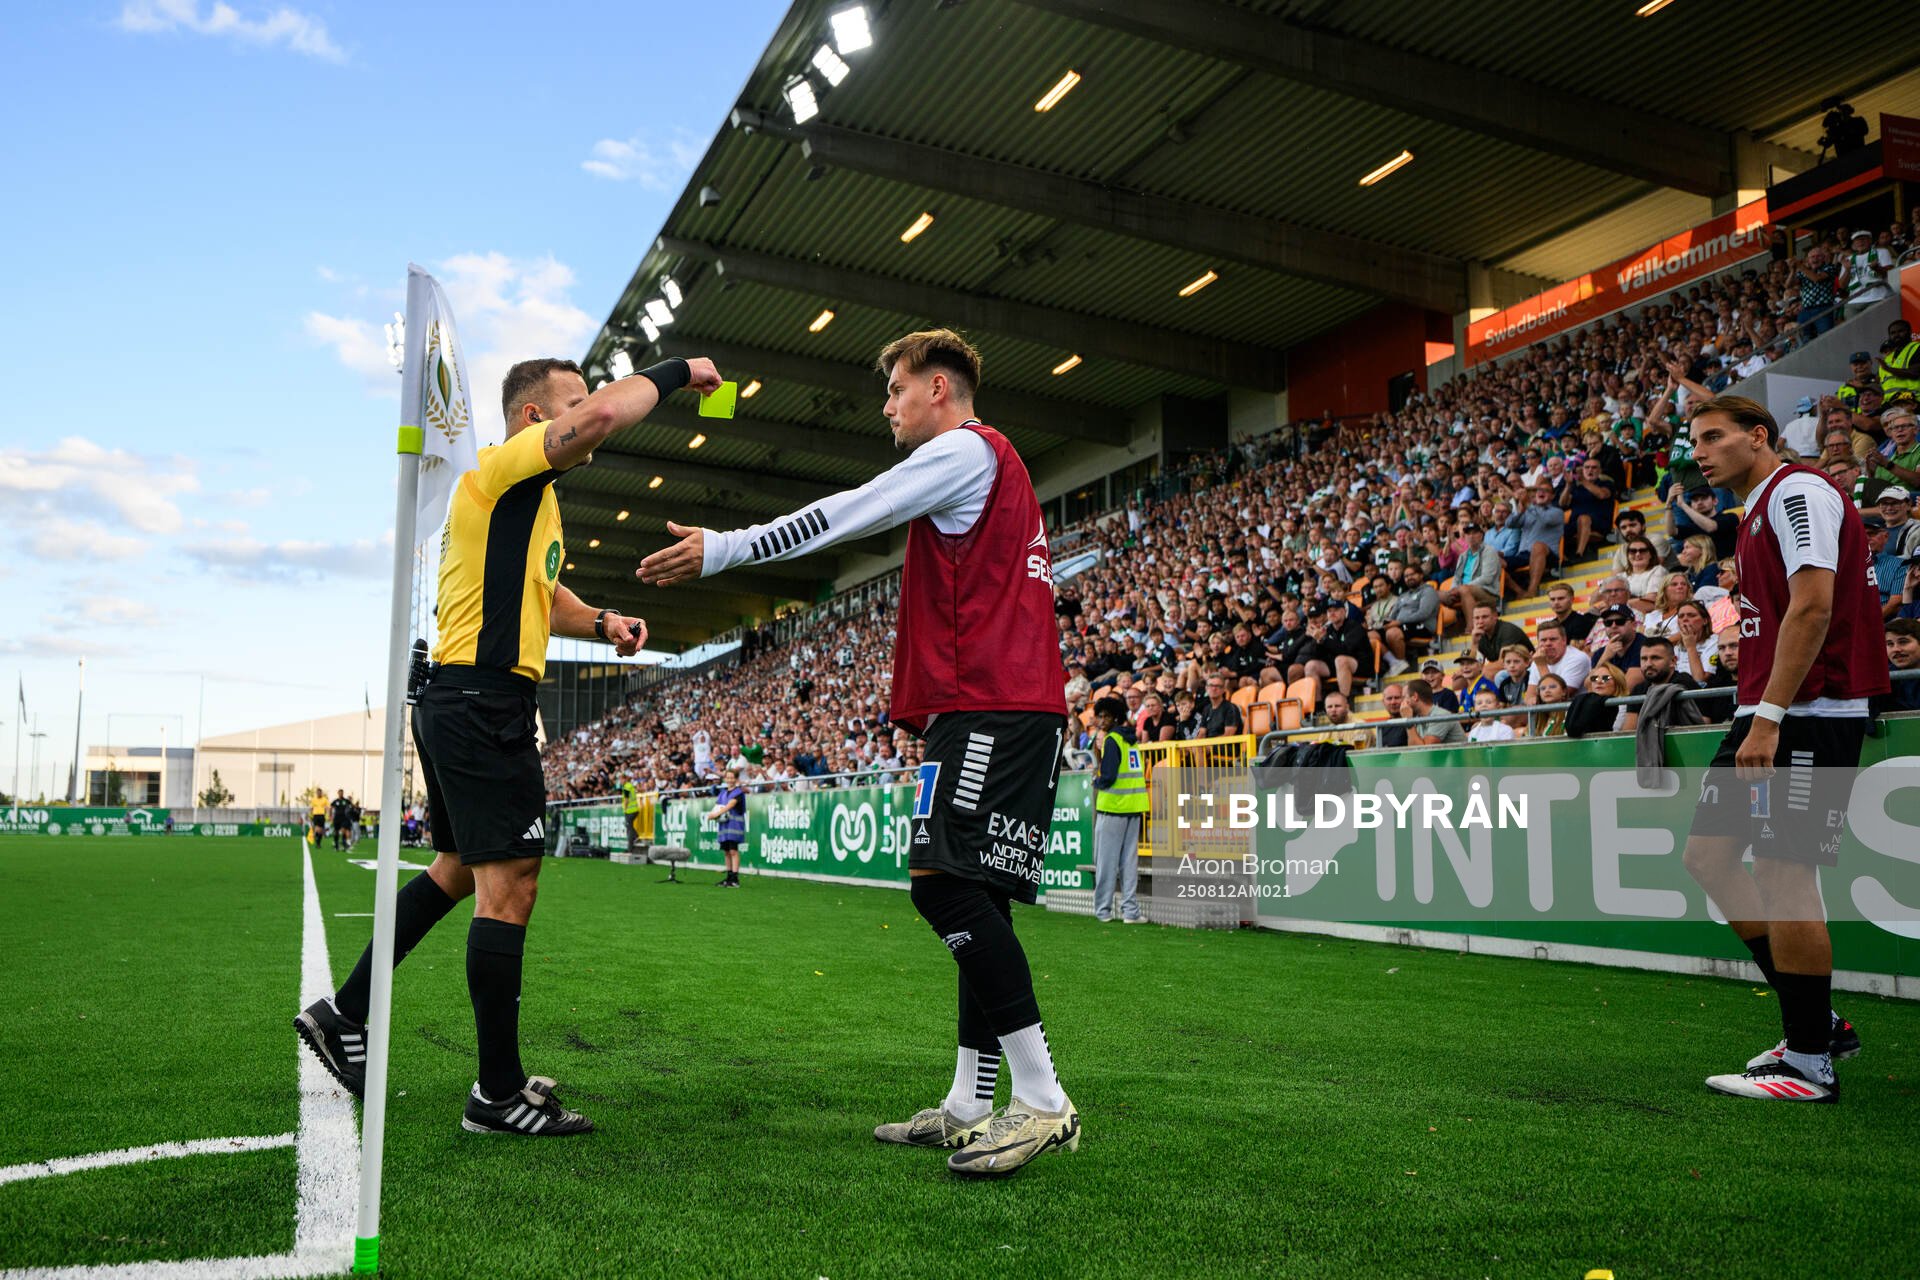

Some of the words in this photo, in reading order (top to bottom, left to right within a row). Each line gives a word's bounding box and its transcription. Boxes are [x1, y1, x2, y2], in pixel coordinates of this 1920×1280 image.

[1616, 220, 1764, 294] Välkommen
[1485, 299, 1568, 347] Swedbank
[1739, 617, 1761, 637] CT
[767, 798, 811, 829] Västerås
[1052, 807, 1080, 821] SON
[760, 833, 818, 864] Byggservice
[1047, 831, 1081, 855] AR
[1374, 756, 1920, 939] INTES
